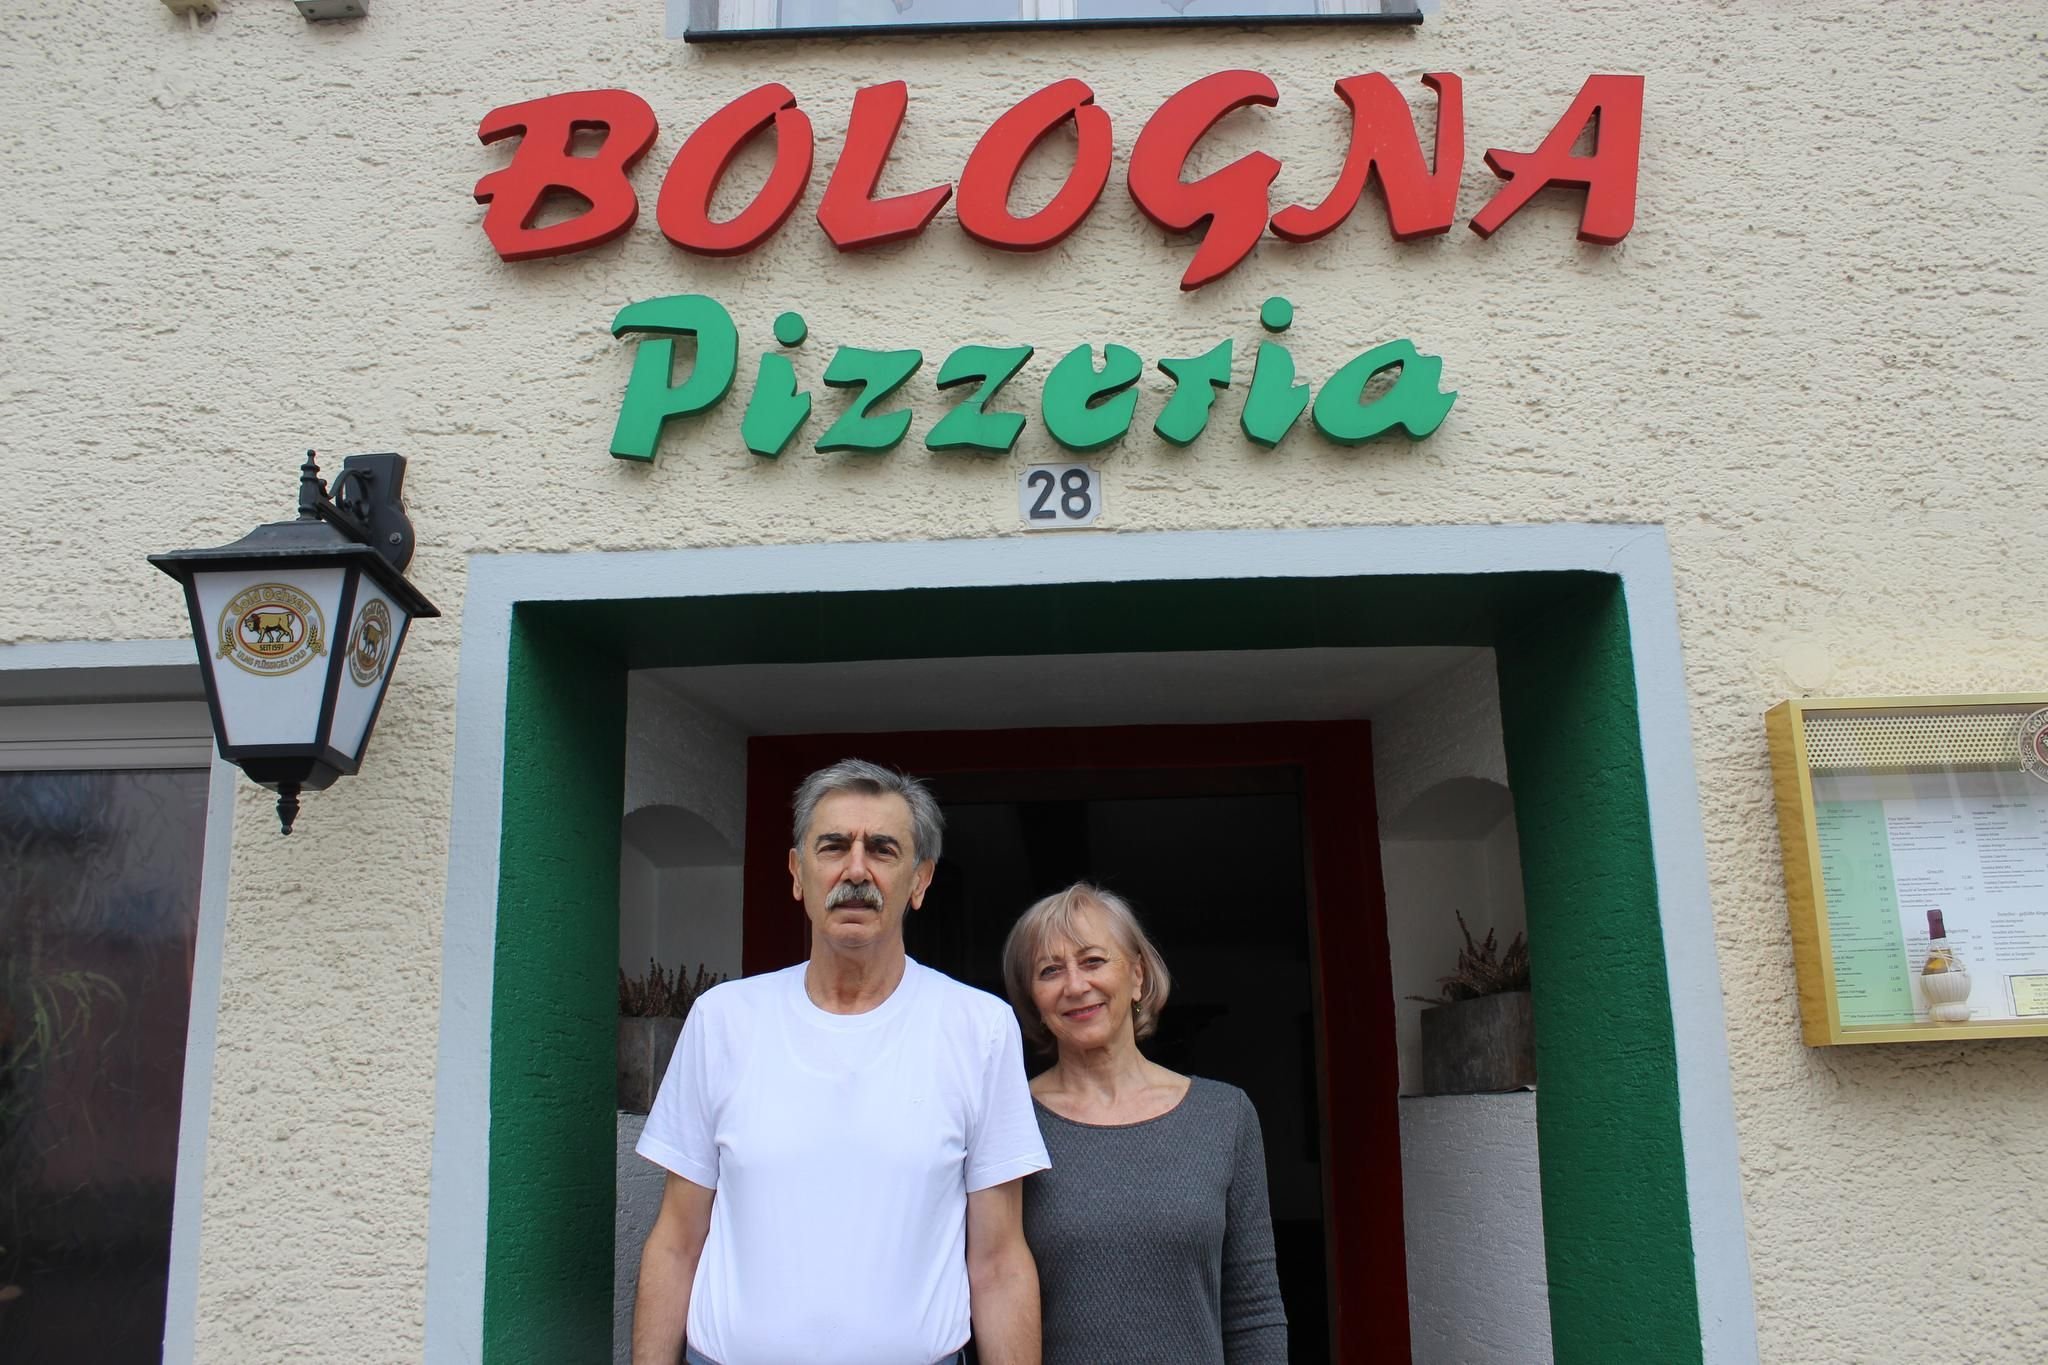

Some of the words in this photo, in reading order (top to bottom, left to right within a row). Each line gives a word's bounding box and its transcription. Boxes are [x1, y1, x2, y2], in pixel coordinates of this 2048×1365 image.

[474, 69, 1645, 293] BOLOGNA
[609, 293, 1458, 462] Pizzeria
[1027, 468, 1092, 520] 28
[231, 591, 260, 616] Gold
